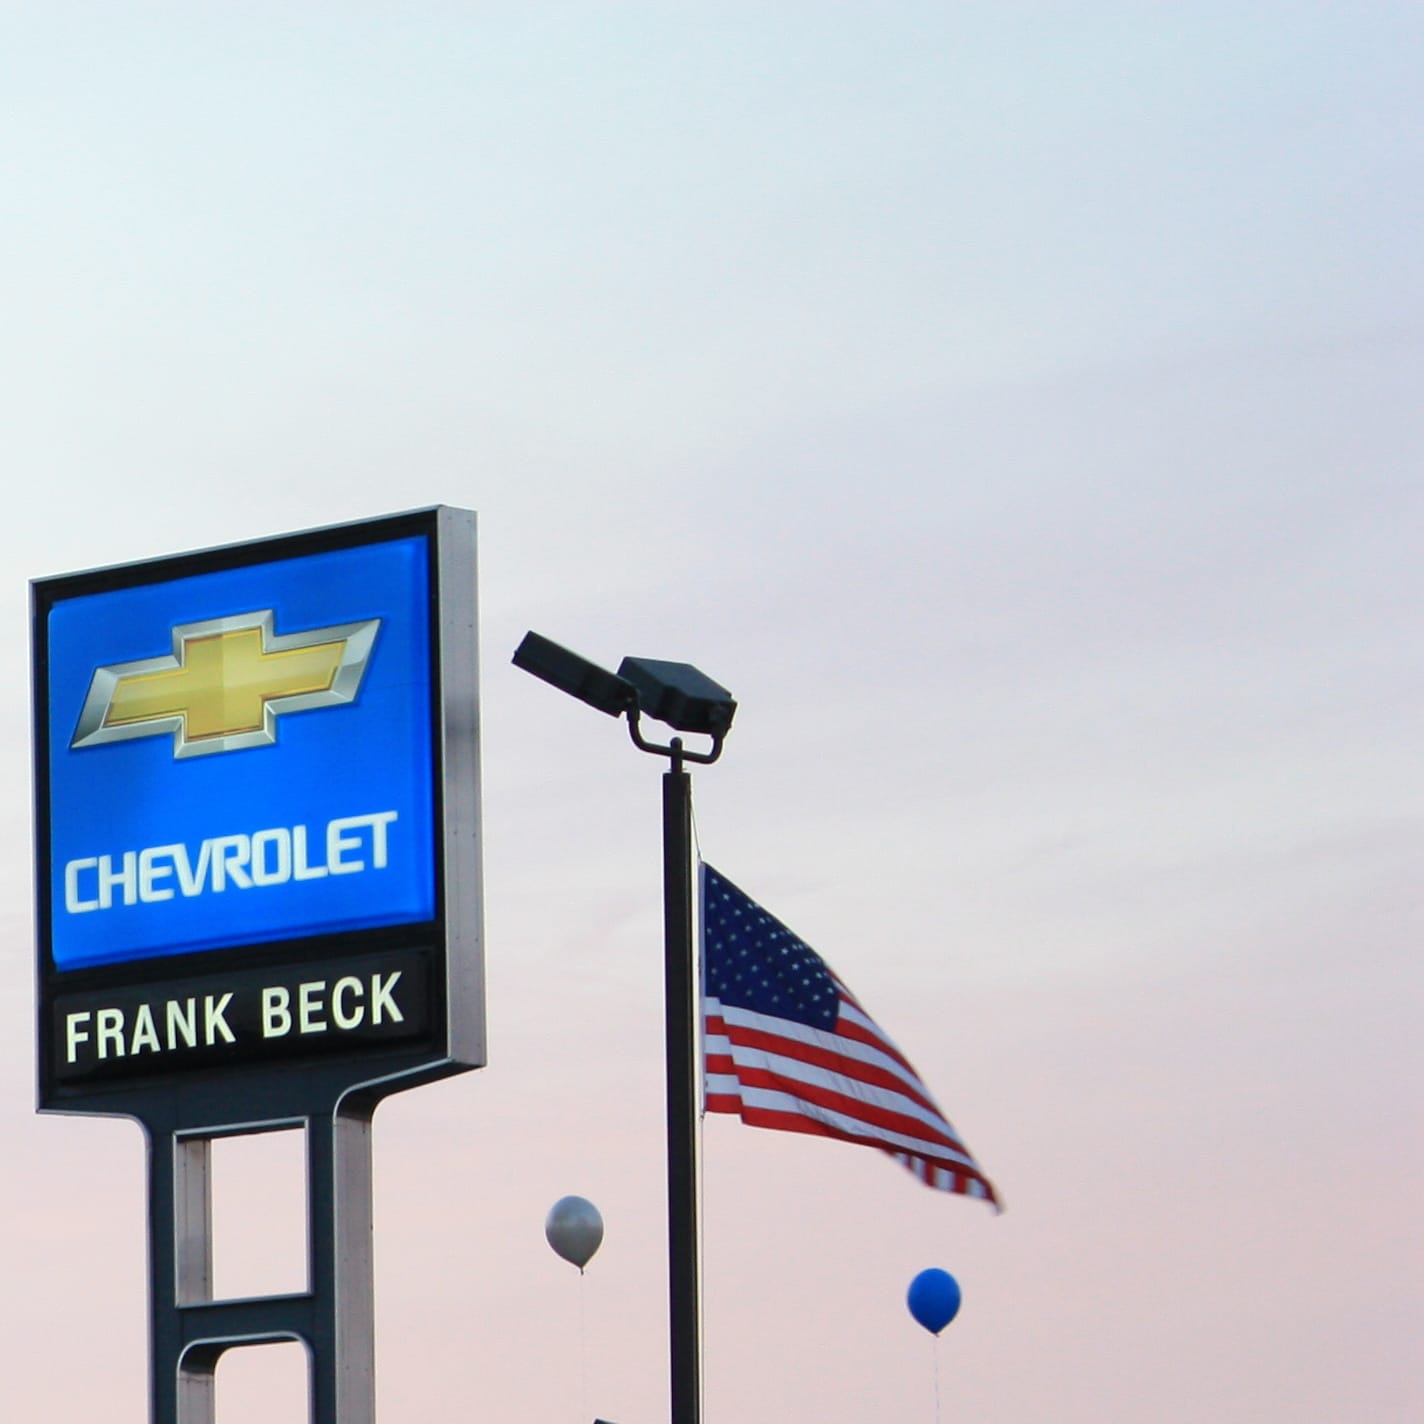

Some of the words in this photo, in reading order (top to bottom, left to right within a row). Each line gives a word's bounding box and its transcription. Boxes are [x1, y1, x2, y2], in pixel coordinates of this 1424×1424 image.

[64, 810, 398, 914] CHEVROLET
[65, 991, 237, 1064] FRANK
[261, 971, 405, 1039] BECK
